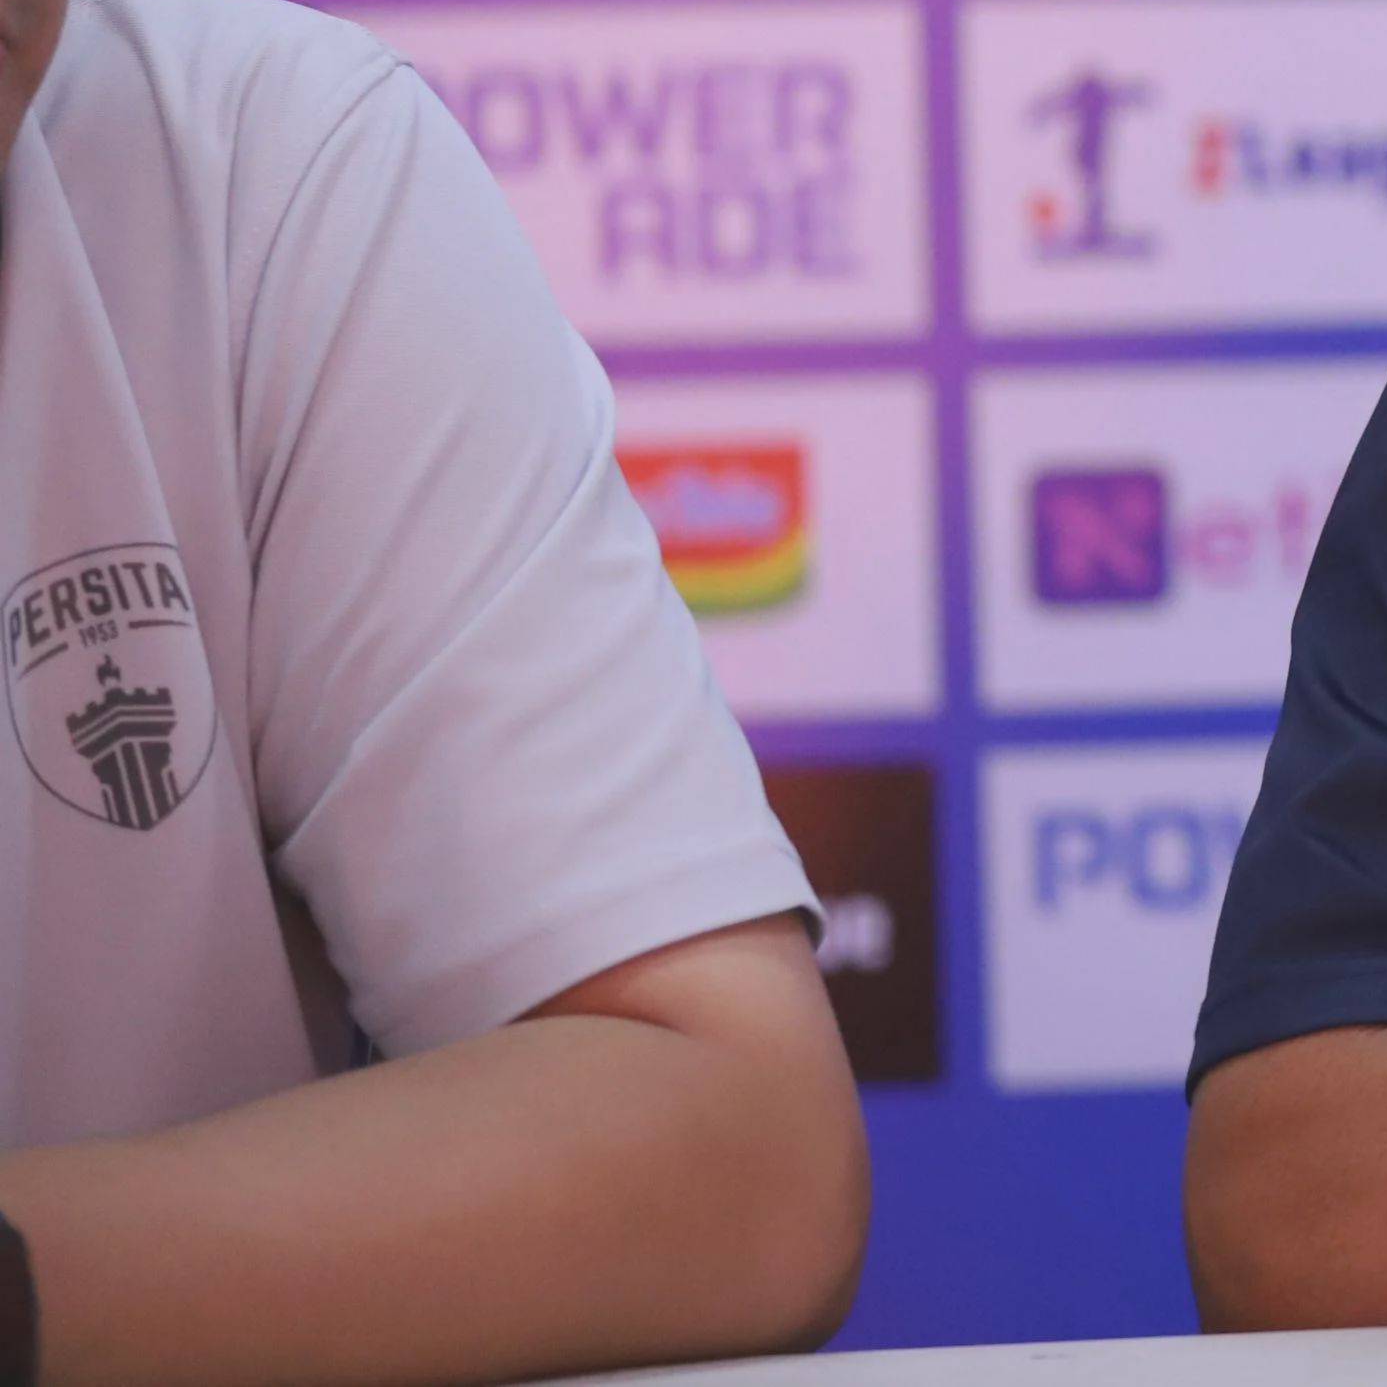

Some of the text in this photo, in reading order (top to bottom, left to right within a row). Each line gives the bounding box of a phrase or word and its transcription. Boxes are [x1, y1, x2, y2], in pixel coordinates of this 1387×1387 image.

[415, 62, 858, 186] OWER
[8, 560, 191, 667] PERSITA
[79, 618, 119, 648] 1953
[1034, 808, 1245, 912] PO
